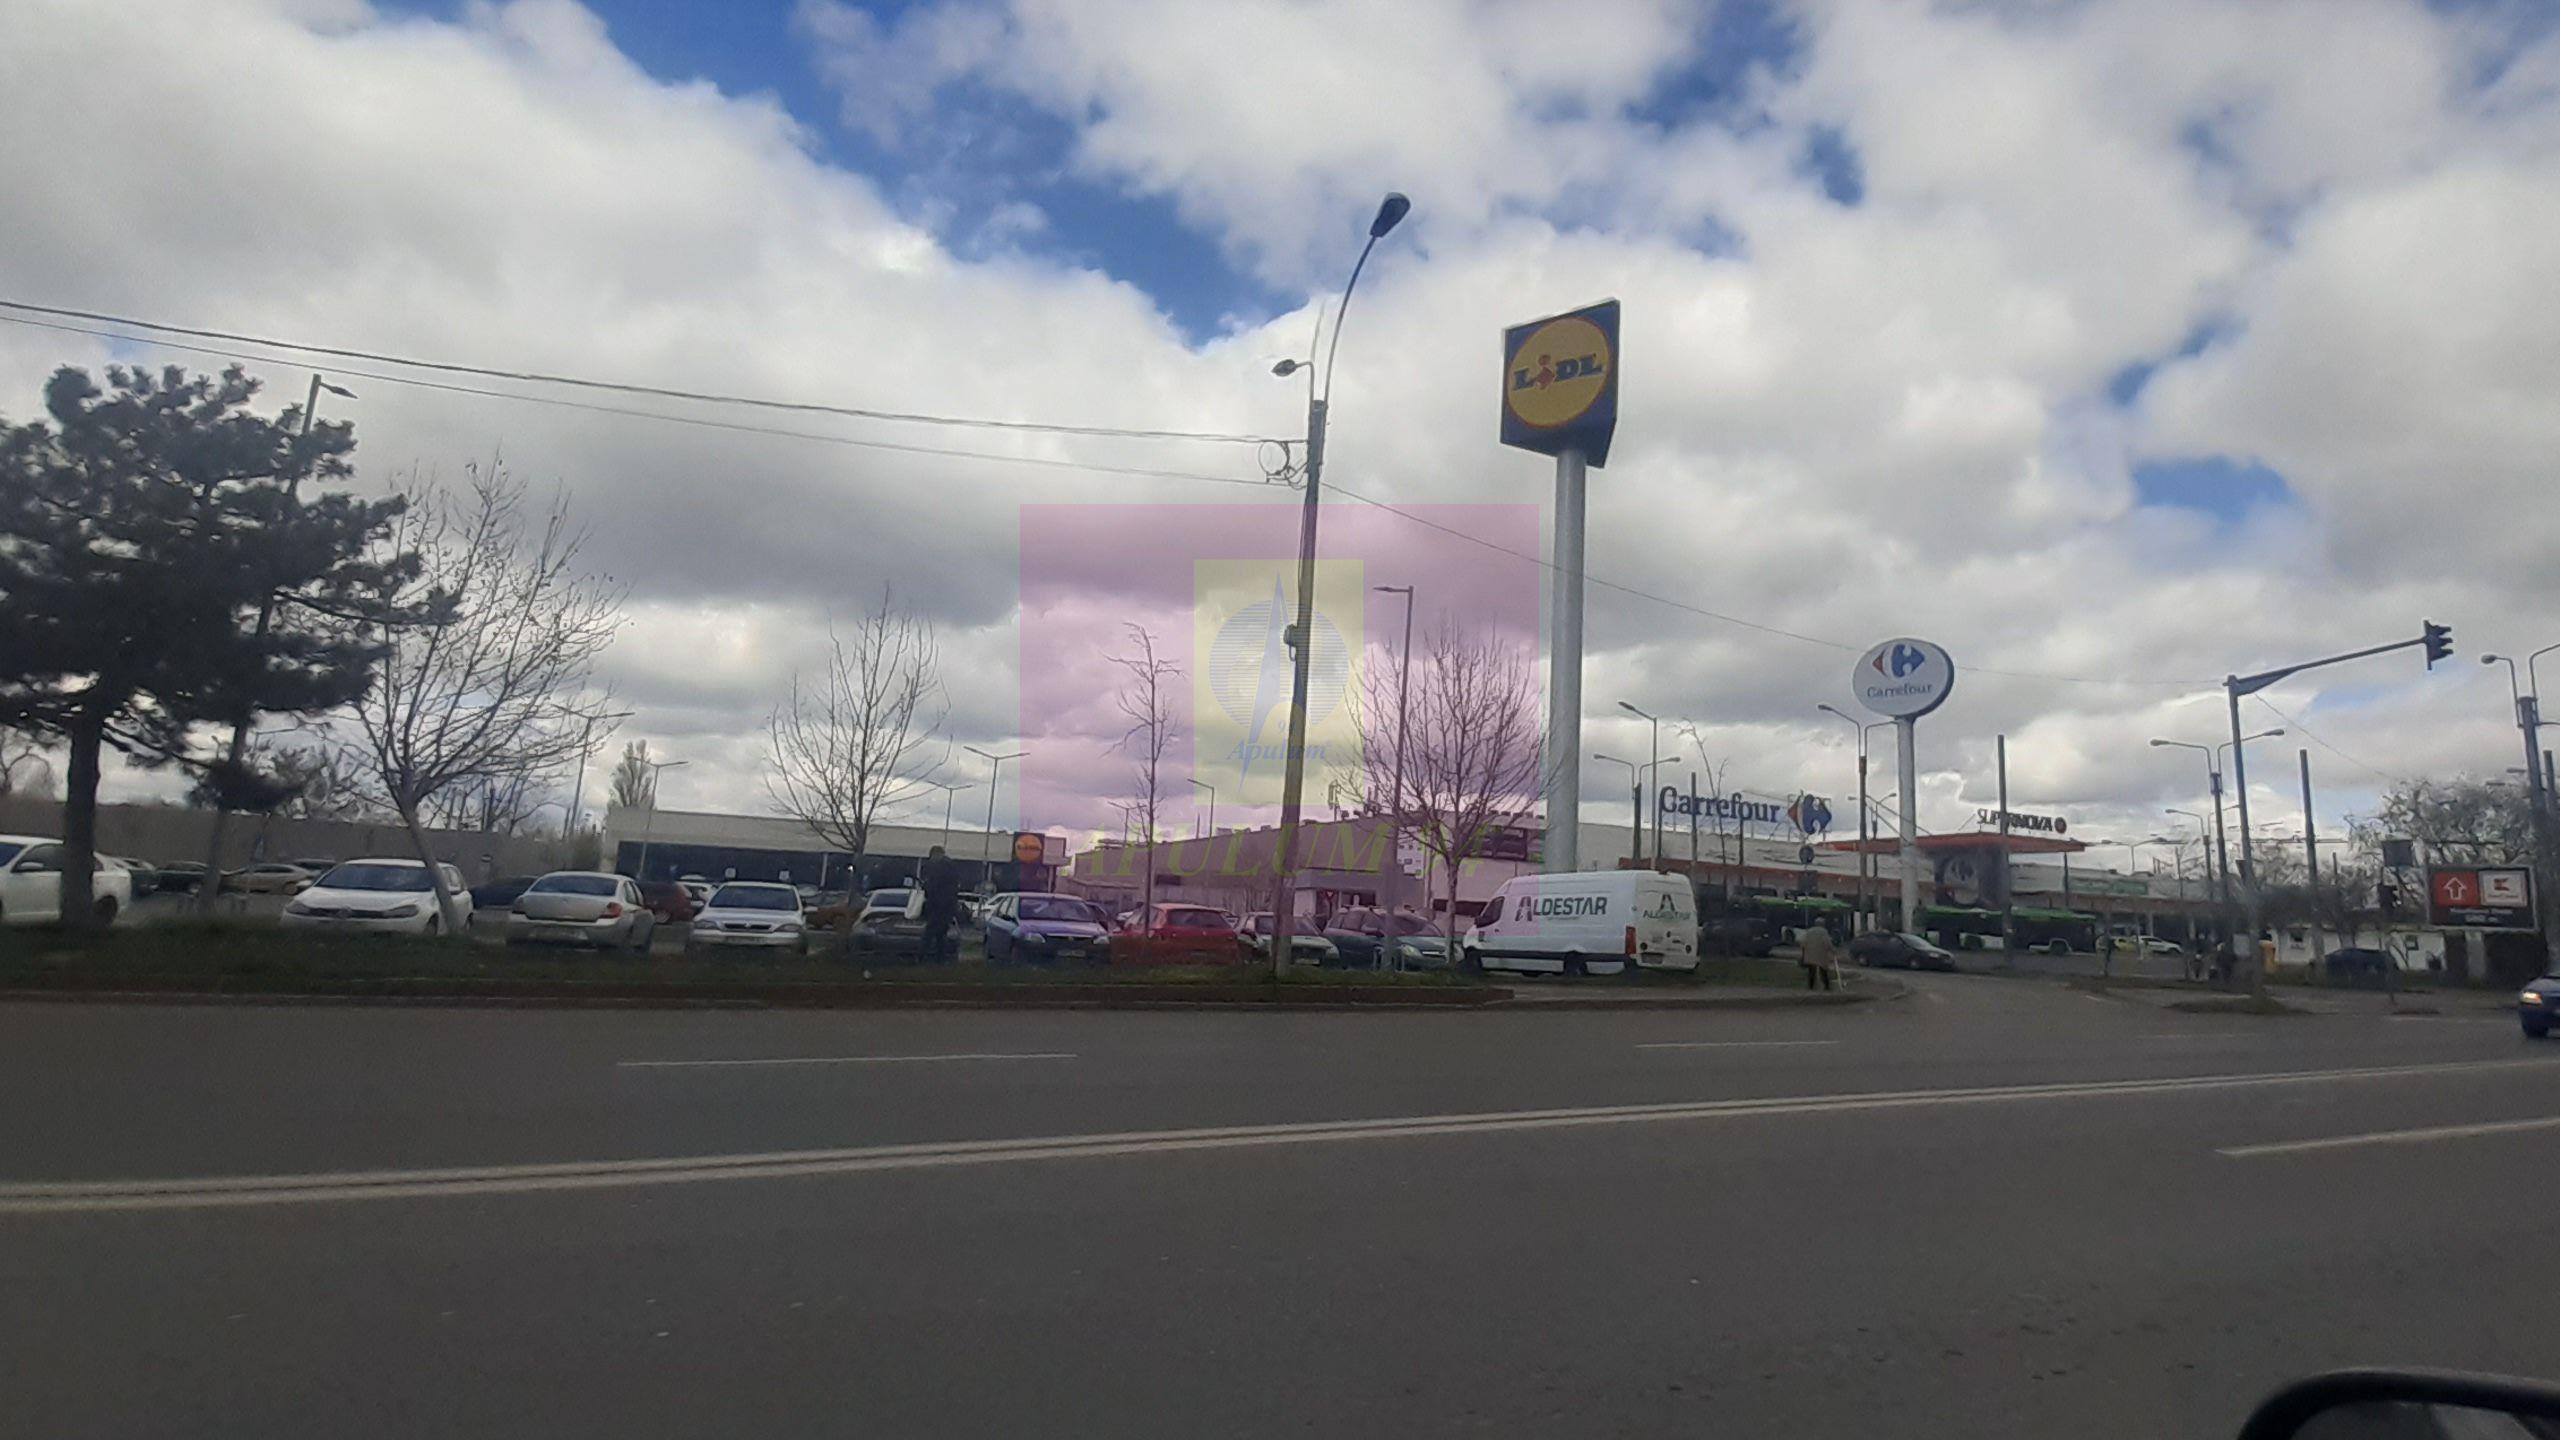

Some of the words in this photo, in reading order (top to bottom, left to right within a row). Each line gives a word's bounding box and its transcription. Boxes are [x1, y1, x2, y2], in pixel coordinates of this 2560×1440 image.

[1867, 683, 1933, 698] Carrefour
[1659, 785, 1781, 823] Carrefour
[1977, 808, 2054, 832] SUPRNOVA
[1514, 896, 1609, 922] ALDESTAR
